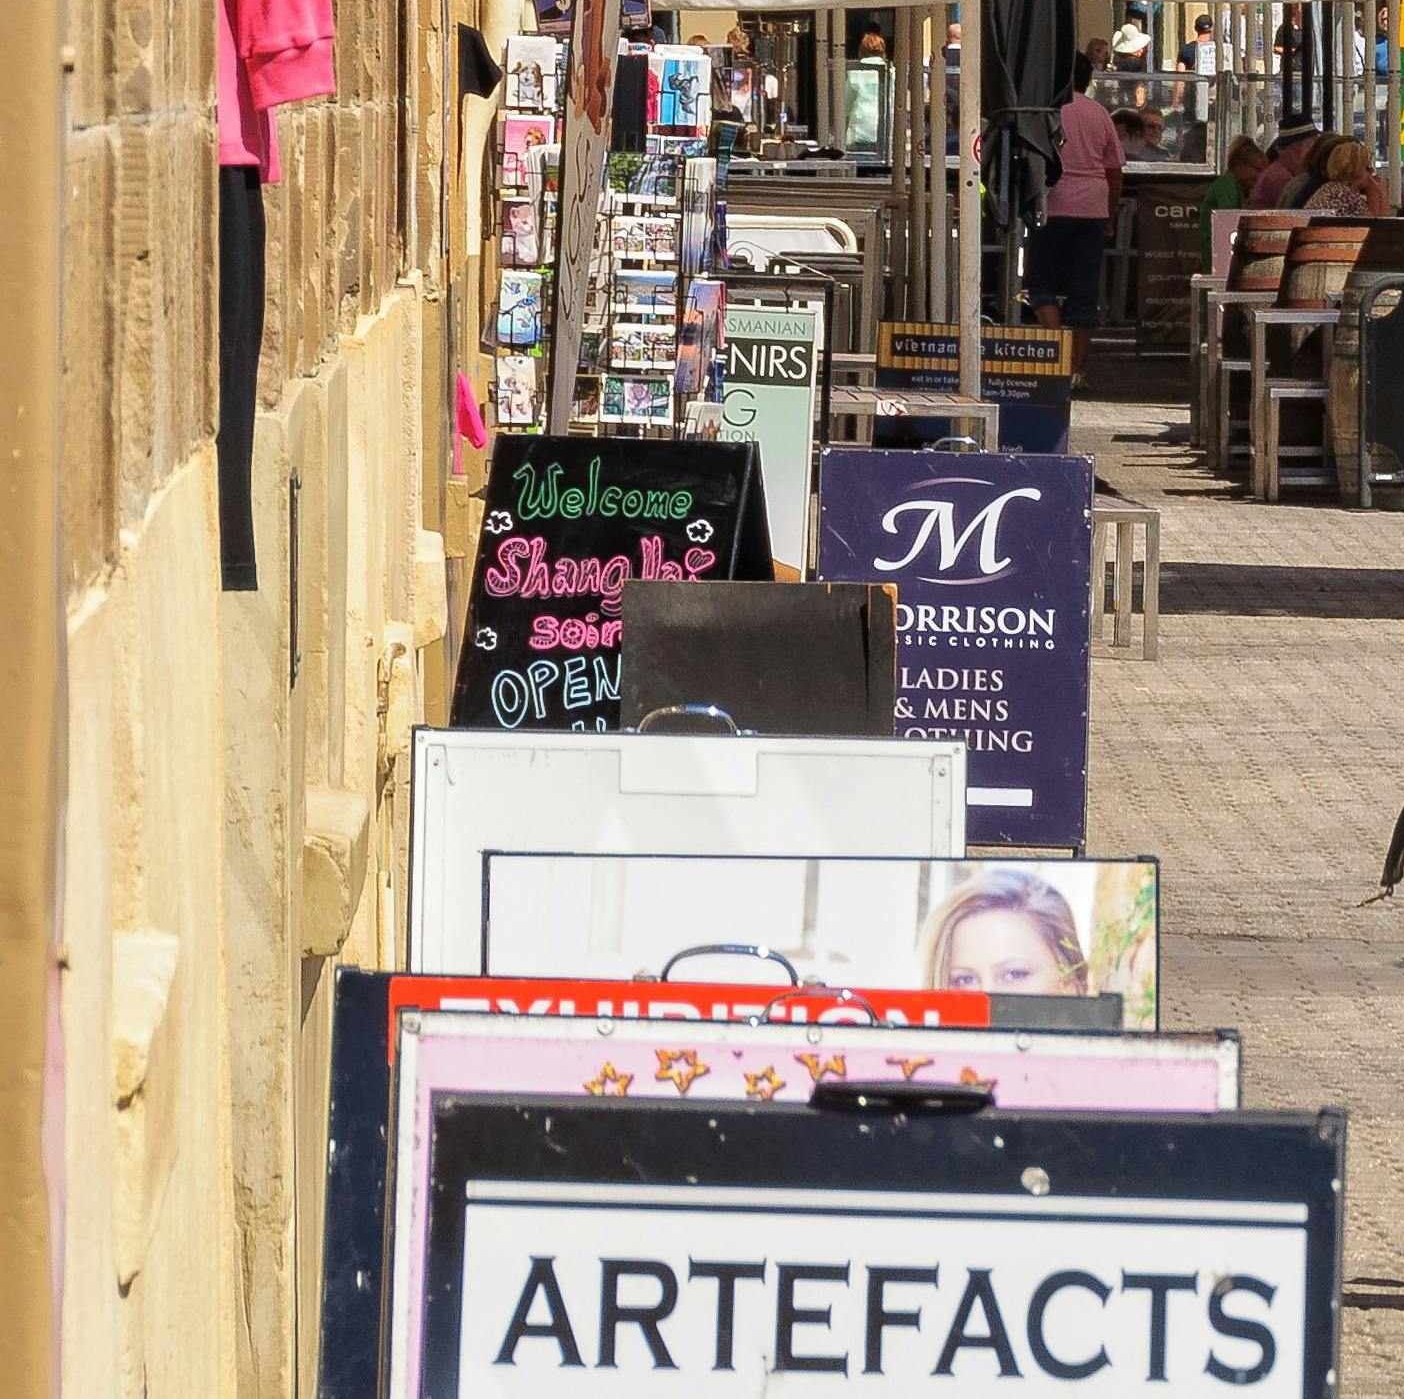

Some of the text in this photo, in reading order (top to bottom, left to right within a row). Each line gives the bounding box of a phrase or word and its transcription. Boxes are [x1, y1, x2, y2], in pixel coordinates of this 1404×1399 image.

[994, 342, 1055, 359] kitchen
[911, 375, 924, 383] eat
[513, 456, 693, 521] Welcome
[873, 486, 1042, 576] M
[948, 636, 1056, 651] CLOTHING
[491, 653, 622, 730] OPEN
[901, 666, 1005, 692] LADIES
[893, 696, 1009, 722] & MENS
[492, 1254, 1279, 1385] ARTEFACTS
